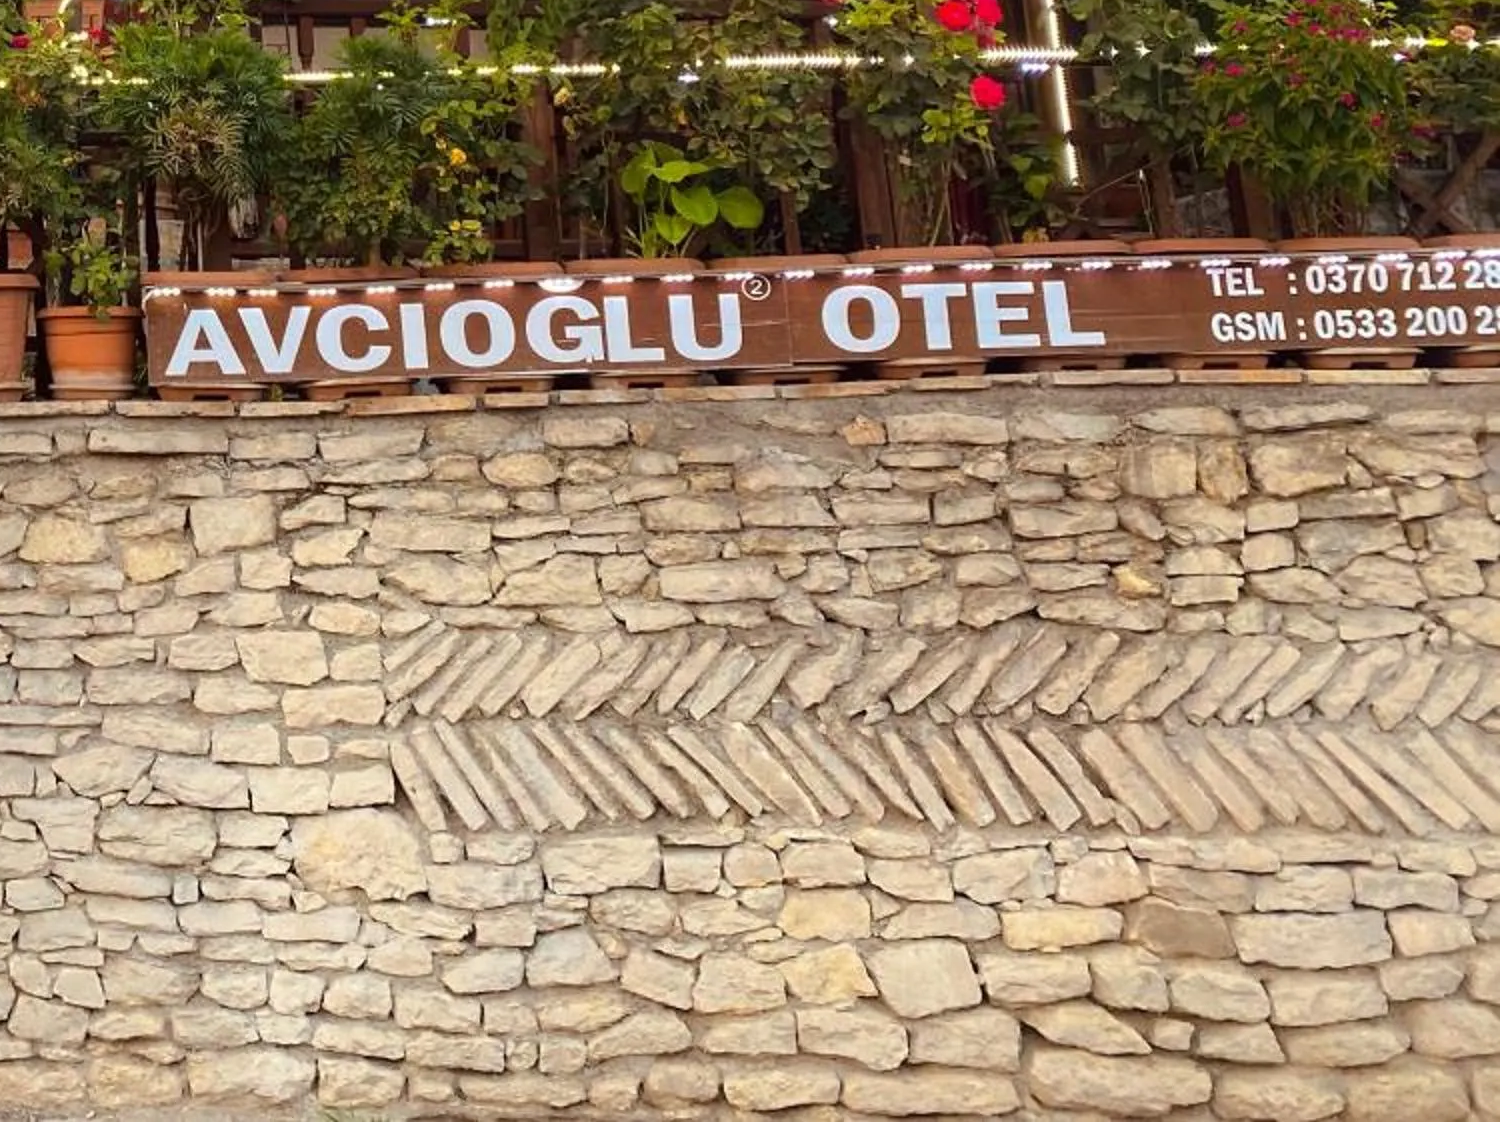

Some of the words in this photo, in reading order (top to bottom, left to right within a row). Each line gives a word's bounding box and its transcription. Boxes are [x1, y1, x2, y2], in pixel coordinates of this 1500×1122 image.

[1206, 267, 1265, 297] TEL
[1305, 263, 1389, 294] 0370
[1396, 261, 1456, 291] 712
[1463, 260, 1500, 290] 28
[821, 280, 1107, 353] OTEL
[1211, 310, 1287, 343] GSM
[1314, 308, 1397, 340] 0533
[1405, 306, 1468, 338] 200
[1474, 305, 1500, 335] 2
